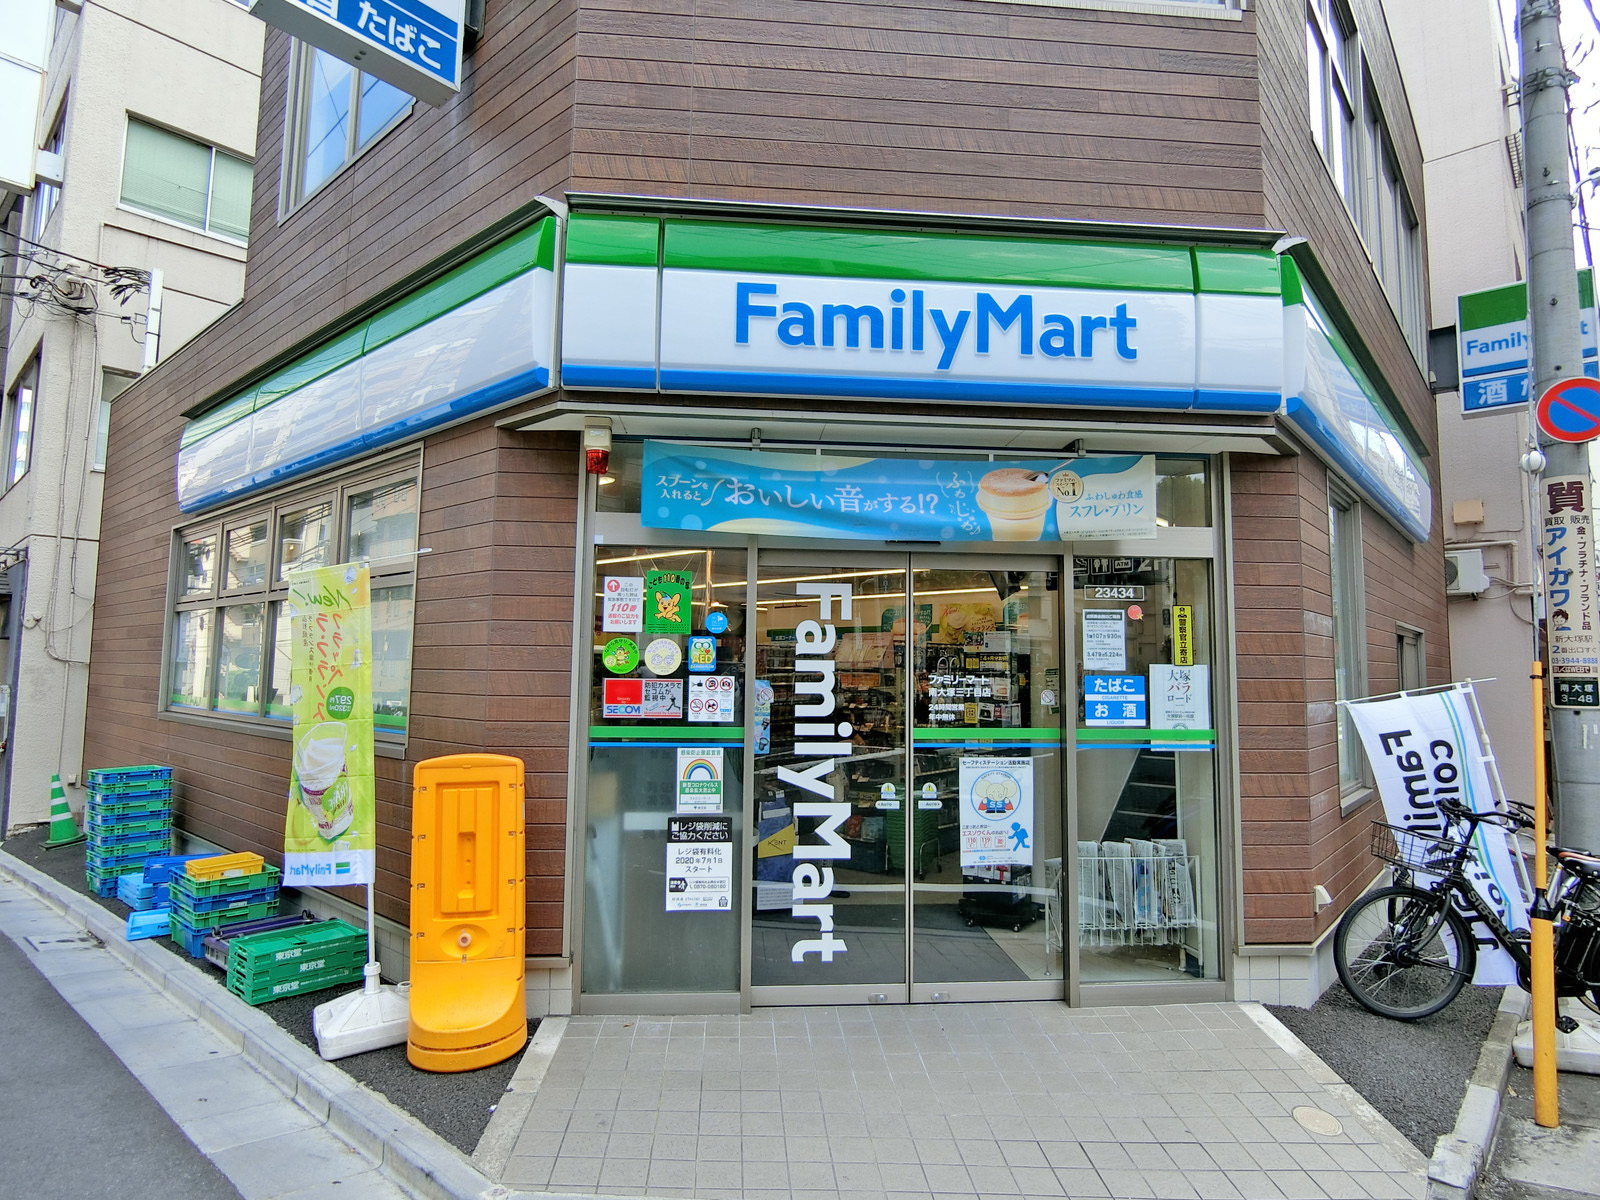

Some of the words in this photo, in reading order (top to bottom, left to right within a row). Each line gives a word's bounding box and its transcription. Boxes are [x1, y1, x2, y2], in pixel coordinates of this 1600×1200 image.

[358, 0, 441, 70] たばこ
[735, 281, 1137, 370] FamilyMart
[1478, 378, 1508, 405] 酒
[660, 489, 702, 501] 入れると
[1085, 489, 1144, 501] ふわしゅわ食感
[1547, 480, 1585, 514] 質
[1544, 517, 1564, 527] 買取
[1570, 514, 1591, 525] 販売
[1095, 586, 1135, 599] 23434
[611, 602, 637, 612] 110番
[1554, 634, 1594, 643] 新大塚駅
[1552, 645, 1597, 654] 2番出口すぐ
[691, 653, 713, 664] AED
[928, 675, 990, 685] ファミリーマート
[1168, 669, 1191, 681] 大塚
[644, 681, 682, 689] 防犯カメラで
[1094, 678, 1135, 693] たばこ
[1167, 682, 1191, 695] バラ
[1560, 684, 1594, 693] 南大塚
[928, 688, 992, 698] 南大塚三丁目店
[1167, 694, 1192, 704] ロード
[1561, 694, 1594, 704] 3-48
[607, 705, 641, 714] SECOM
[928, 703, 965, 711] 24時間営業
[1094, 703, 1137, 718] お酒
[928, 713, 956, 721] 年中無休
[778, 583, 853, 962] FamilyMart
[680, 821, 728, 831] レジ袋削減に
[671, 831, 729, 840] ご協力ください
[768, 839, 787, 848] KENT
[675, 856, 723, 864] 2020年7月1日
[685, 865, 713, 873] スタート
